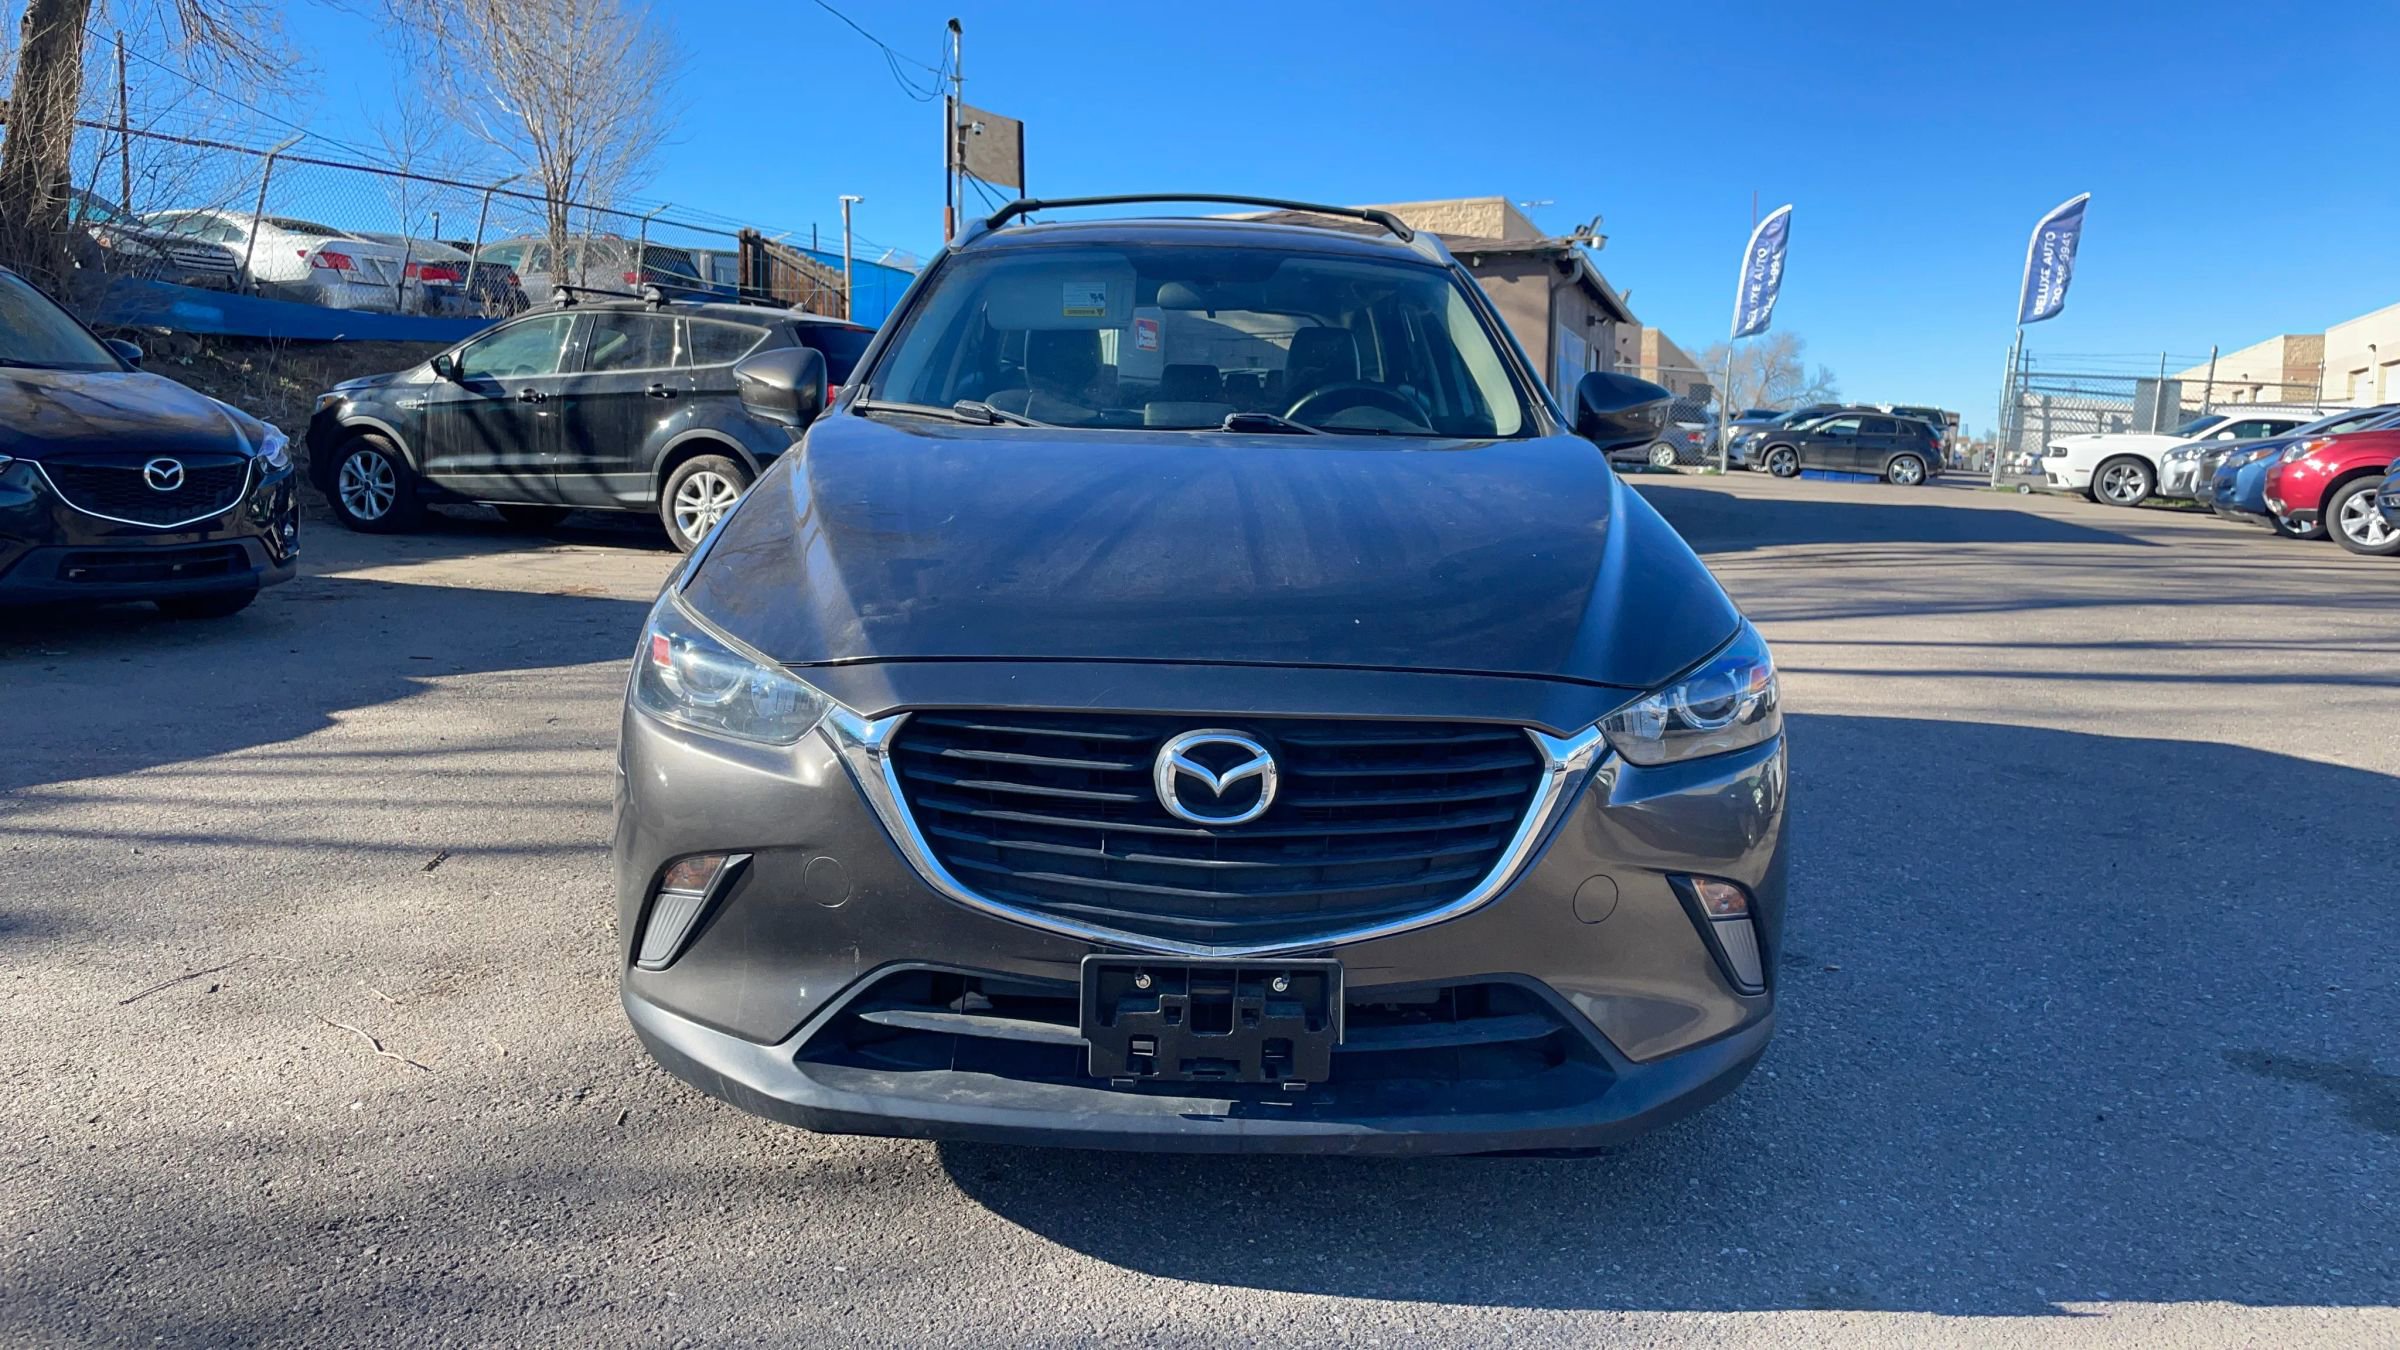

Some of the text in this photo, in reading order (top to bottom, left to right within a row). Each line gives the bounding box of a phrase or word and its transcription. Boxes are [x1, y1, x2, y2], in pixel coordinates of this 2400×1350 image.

[1754, 247, 1767, 281] AUTO
[2033, 231, 2056, 316] DELUXE AUTO
